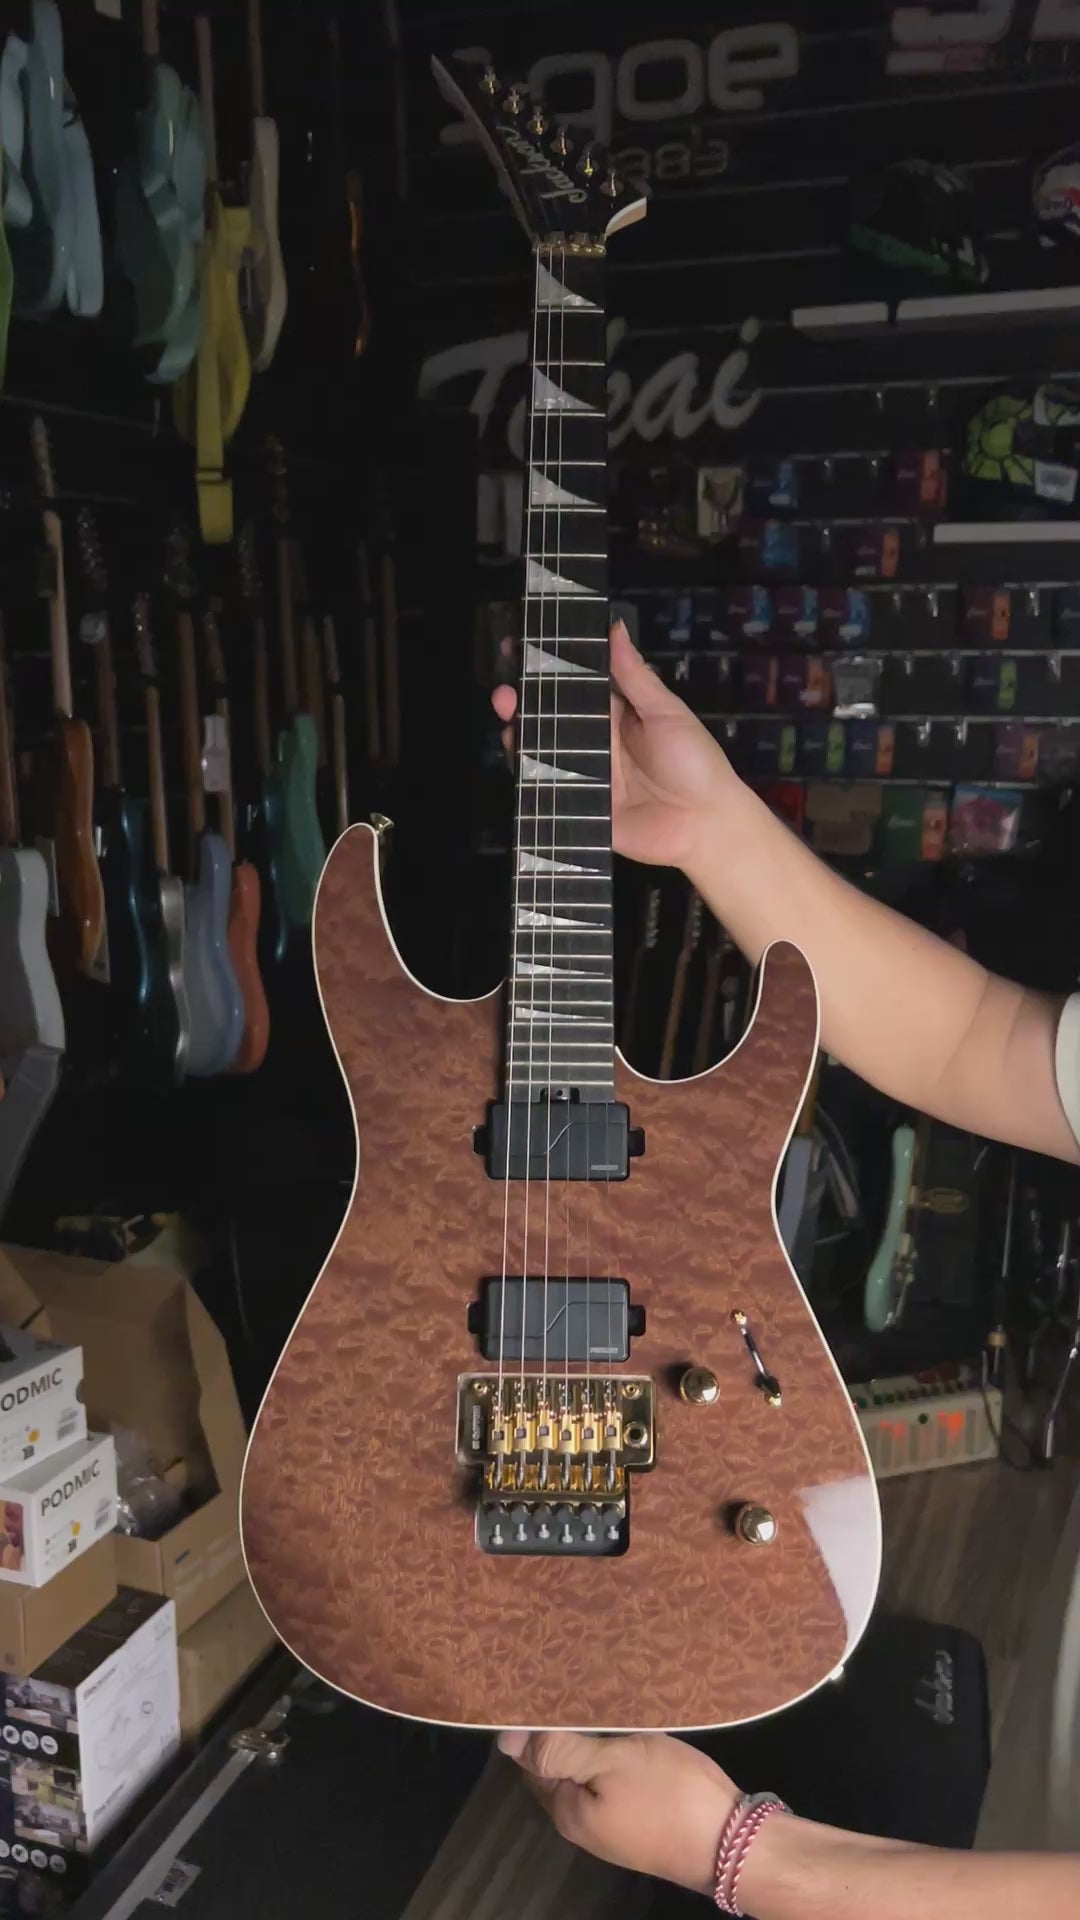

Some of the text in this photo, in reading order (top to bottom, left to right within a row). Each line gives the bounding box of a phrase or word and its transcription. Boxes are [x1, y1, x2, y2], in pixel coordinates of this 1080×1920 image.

[496, 125, 587, 204] Jackson
[417, 316, 763, 462] Tkai
[0, 1367, 63, 1412] ODMIC
[40, 1459, 101, 1517] PODMIC
